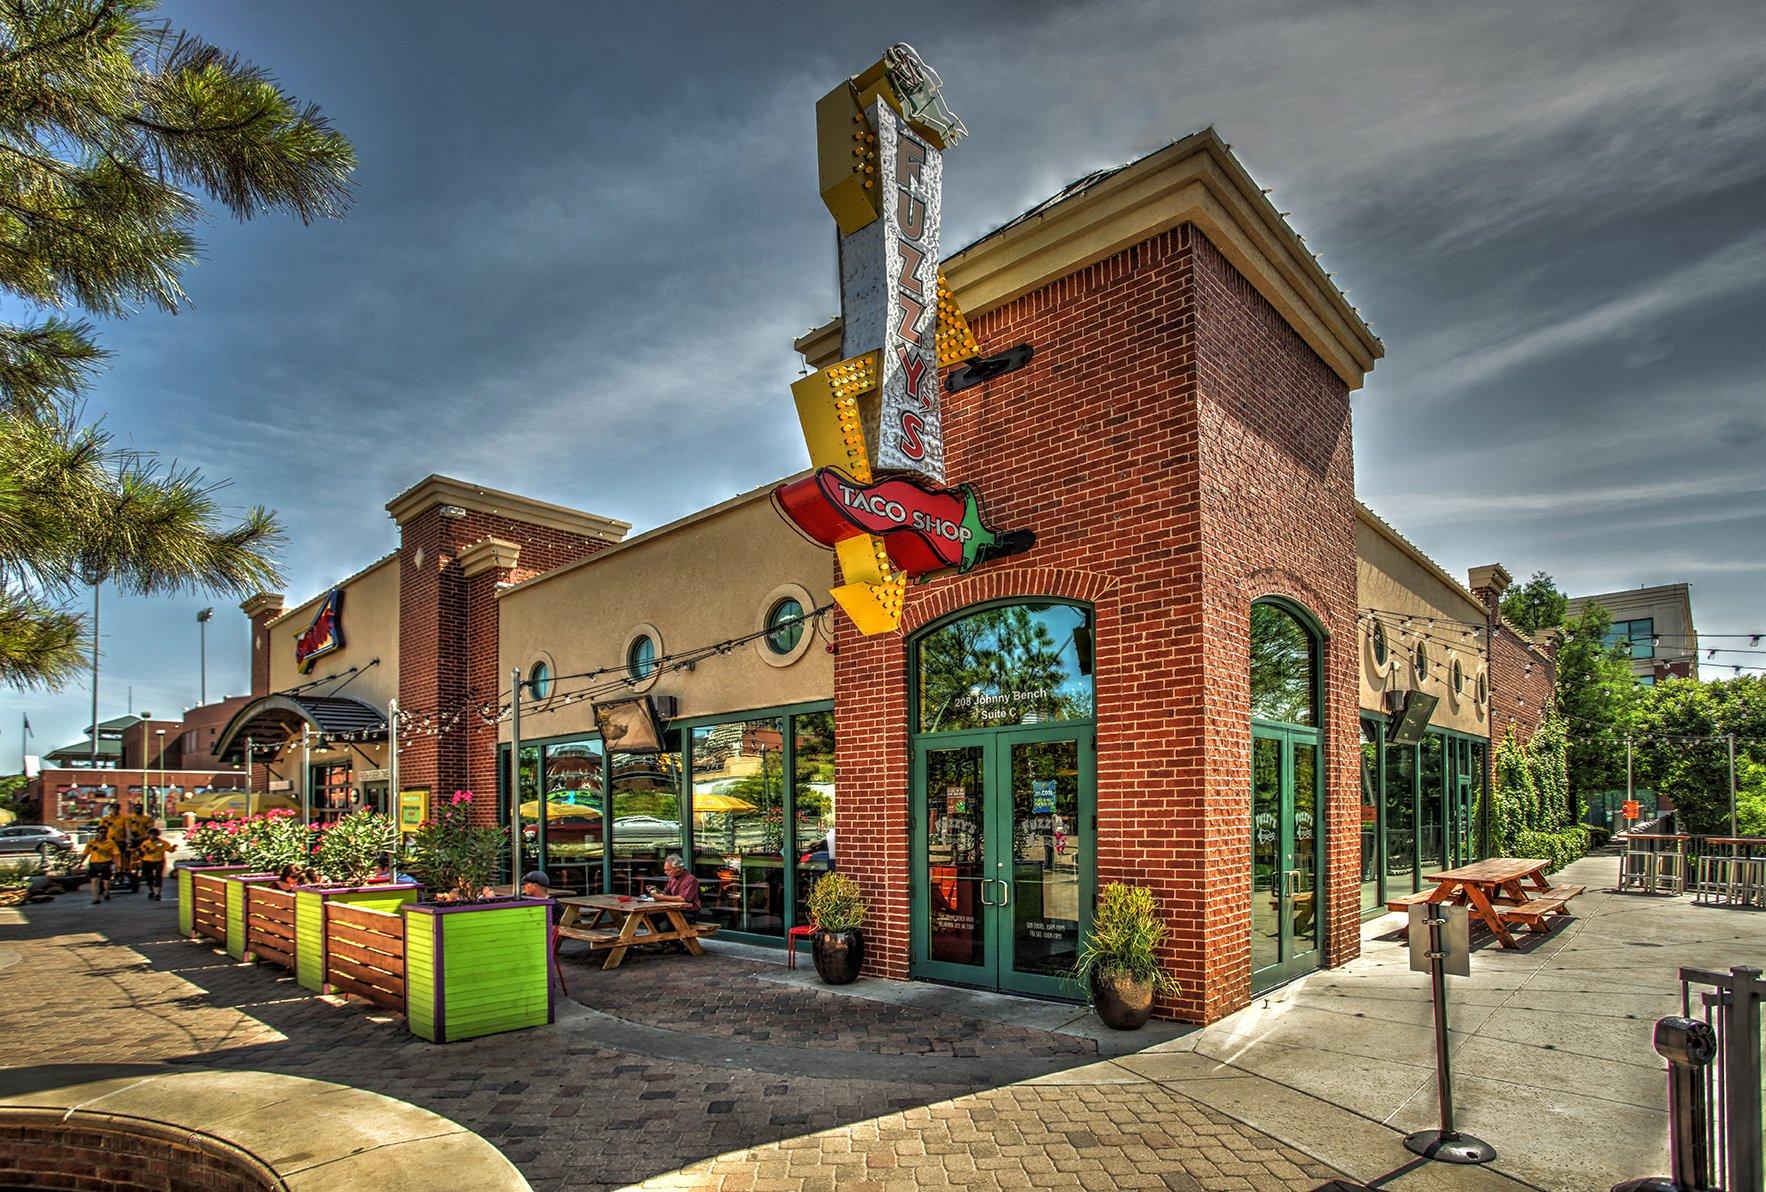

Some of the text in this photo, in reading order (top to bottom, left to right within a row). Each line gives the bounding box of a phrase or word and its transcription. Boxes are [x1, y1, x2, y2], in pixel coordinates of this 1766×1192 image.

[897, 136, 931, 462] FUZZY'S
[838, 483, 973, 543] TACO SHOP
[955, 687, 1047, 707] 208 Johnny Bench
[981, 708, 1017, 720] Suite C
[1021, 817, 1070, 836] FUZZS
